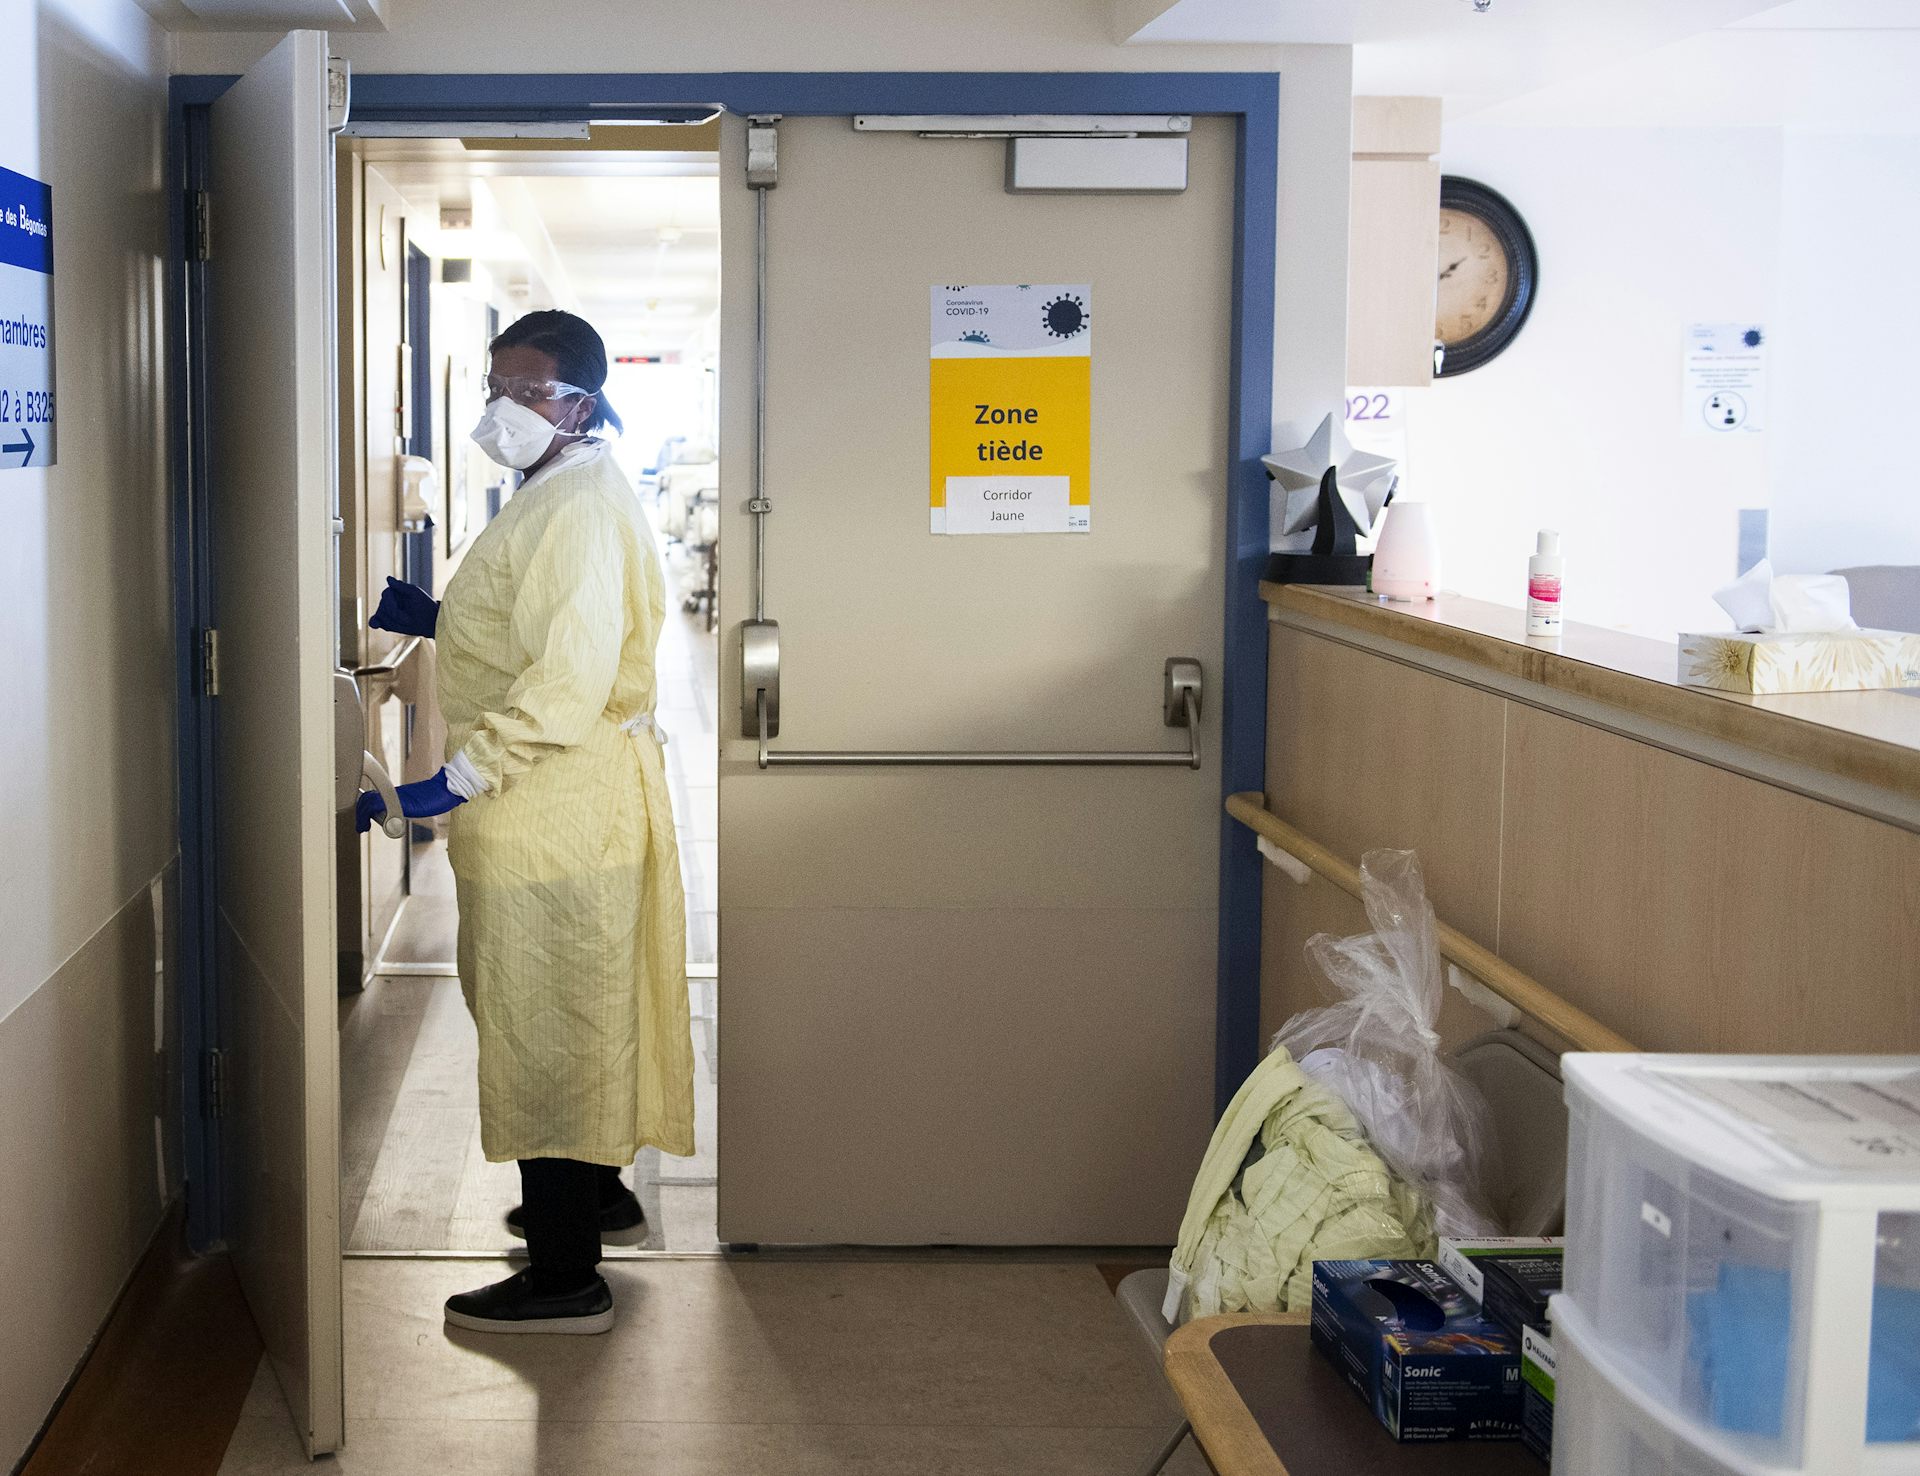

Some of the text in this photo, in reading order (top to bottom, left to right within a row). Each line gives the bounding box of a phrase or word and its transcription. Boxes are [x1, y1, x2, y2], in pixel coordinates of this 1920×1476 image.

[5, 207, 17, 226] des
[19, 204, 48, 237] Bégonias
[945, 307, 989, 316] COVID-19
[15, 390, 21, 423] à
[27, 391, 55, 423] B325
[974, 404, 1039, 425] Zone
[976, 439, 1044, 461] tiède
[983, 489, 1033, 501] Corridor
[990, 510, 1025, 522] Jaune
[1416, 1263, 1446, 1285] Sonic
[1312, 1273, 1329, 1298] Sonic
[1404, 1365, 1441, 1378] Sonic
[1505, 1367, 1519, 1381] M
